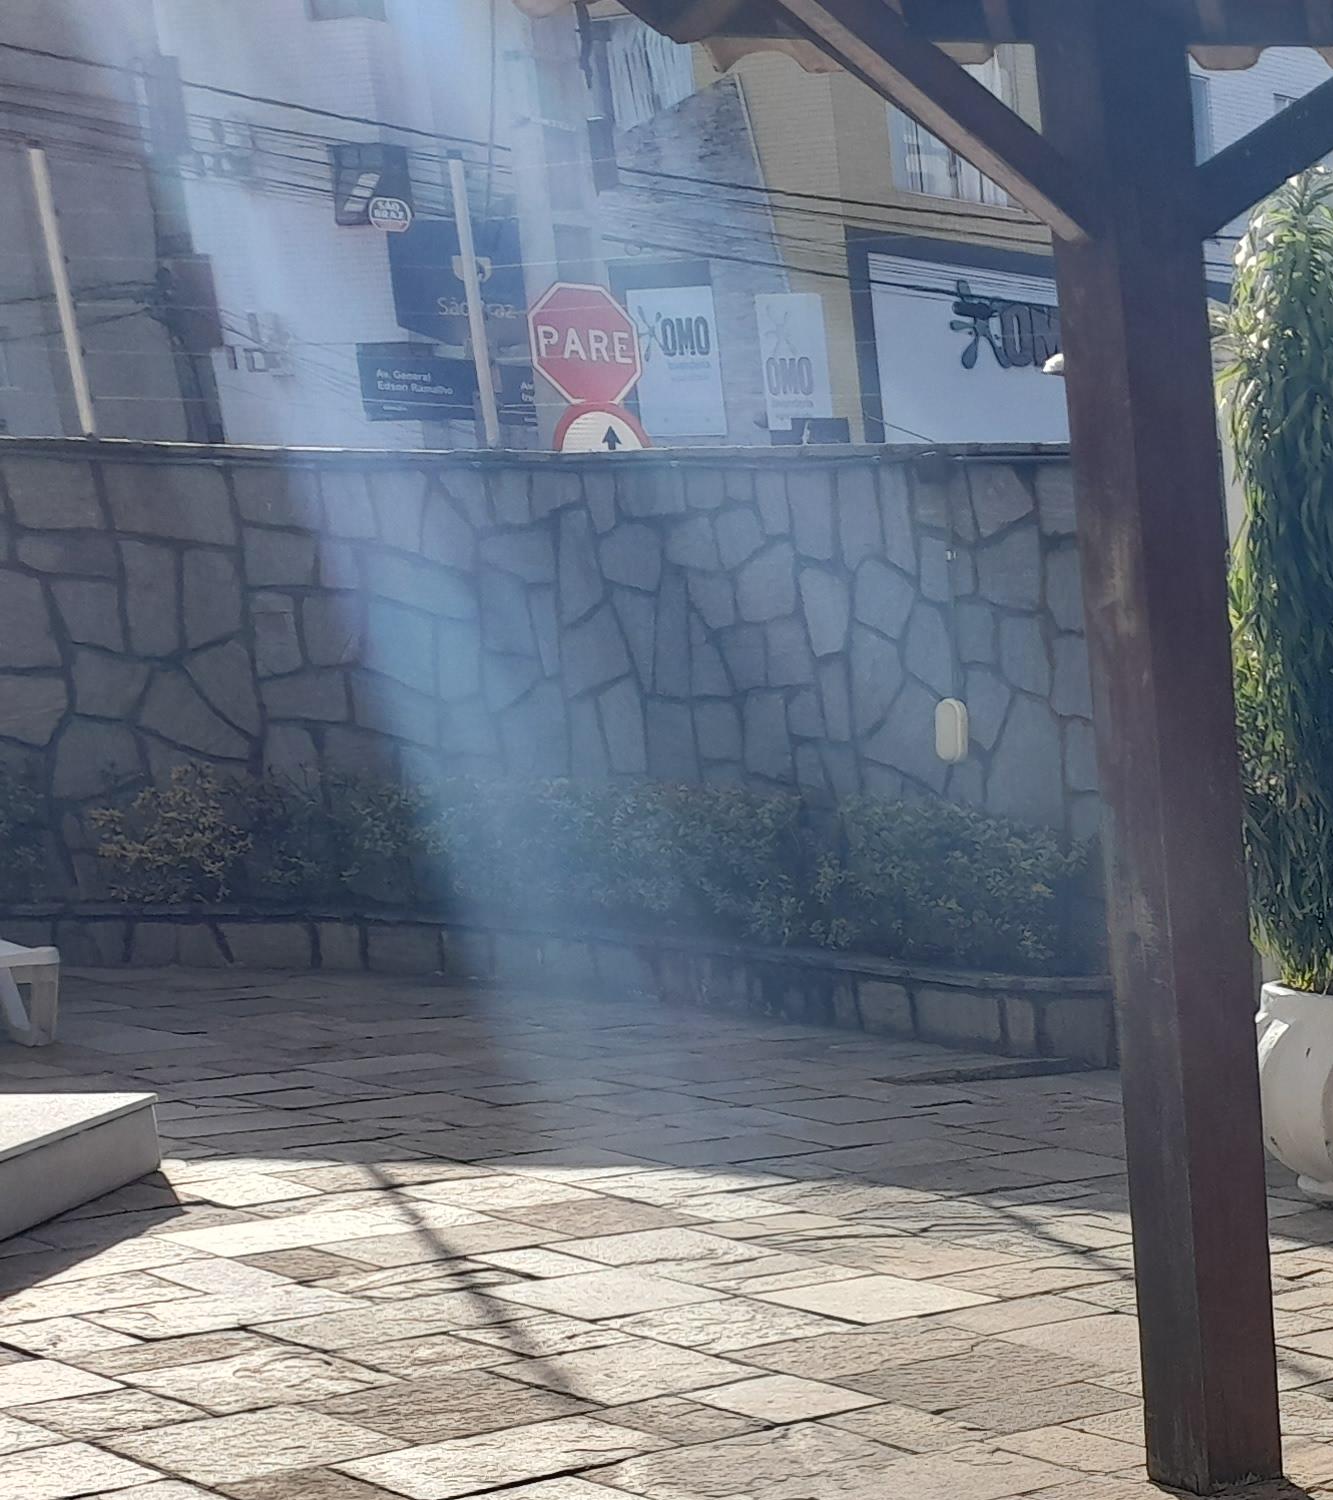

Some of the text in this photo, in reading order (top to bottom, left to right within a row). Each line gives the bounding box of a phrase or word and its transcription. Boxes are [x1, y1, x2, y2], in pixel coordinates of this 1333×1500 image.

[537, 325, 634, 364] PARE
[660, 316, 711, 357] OMO
[766, 356, 814, 396] OMO
